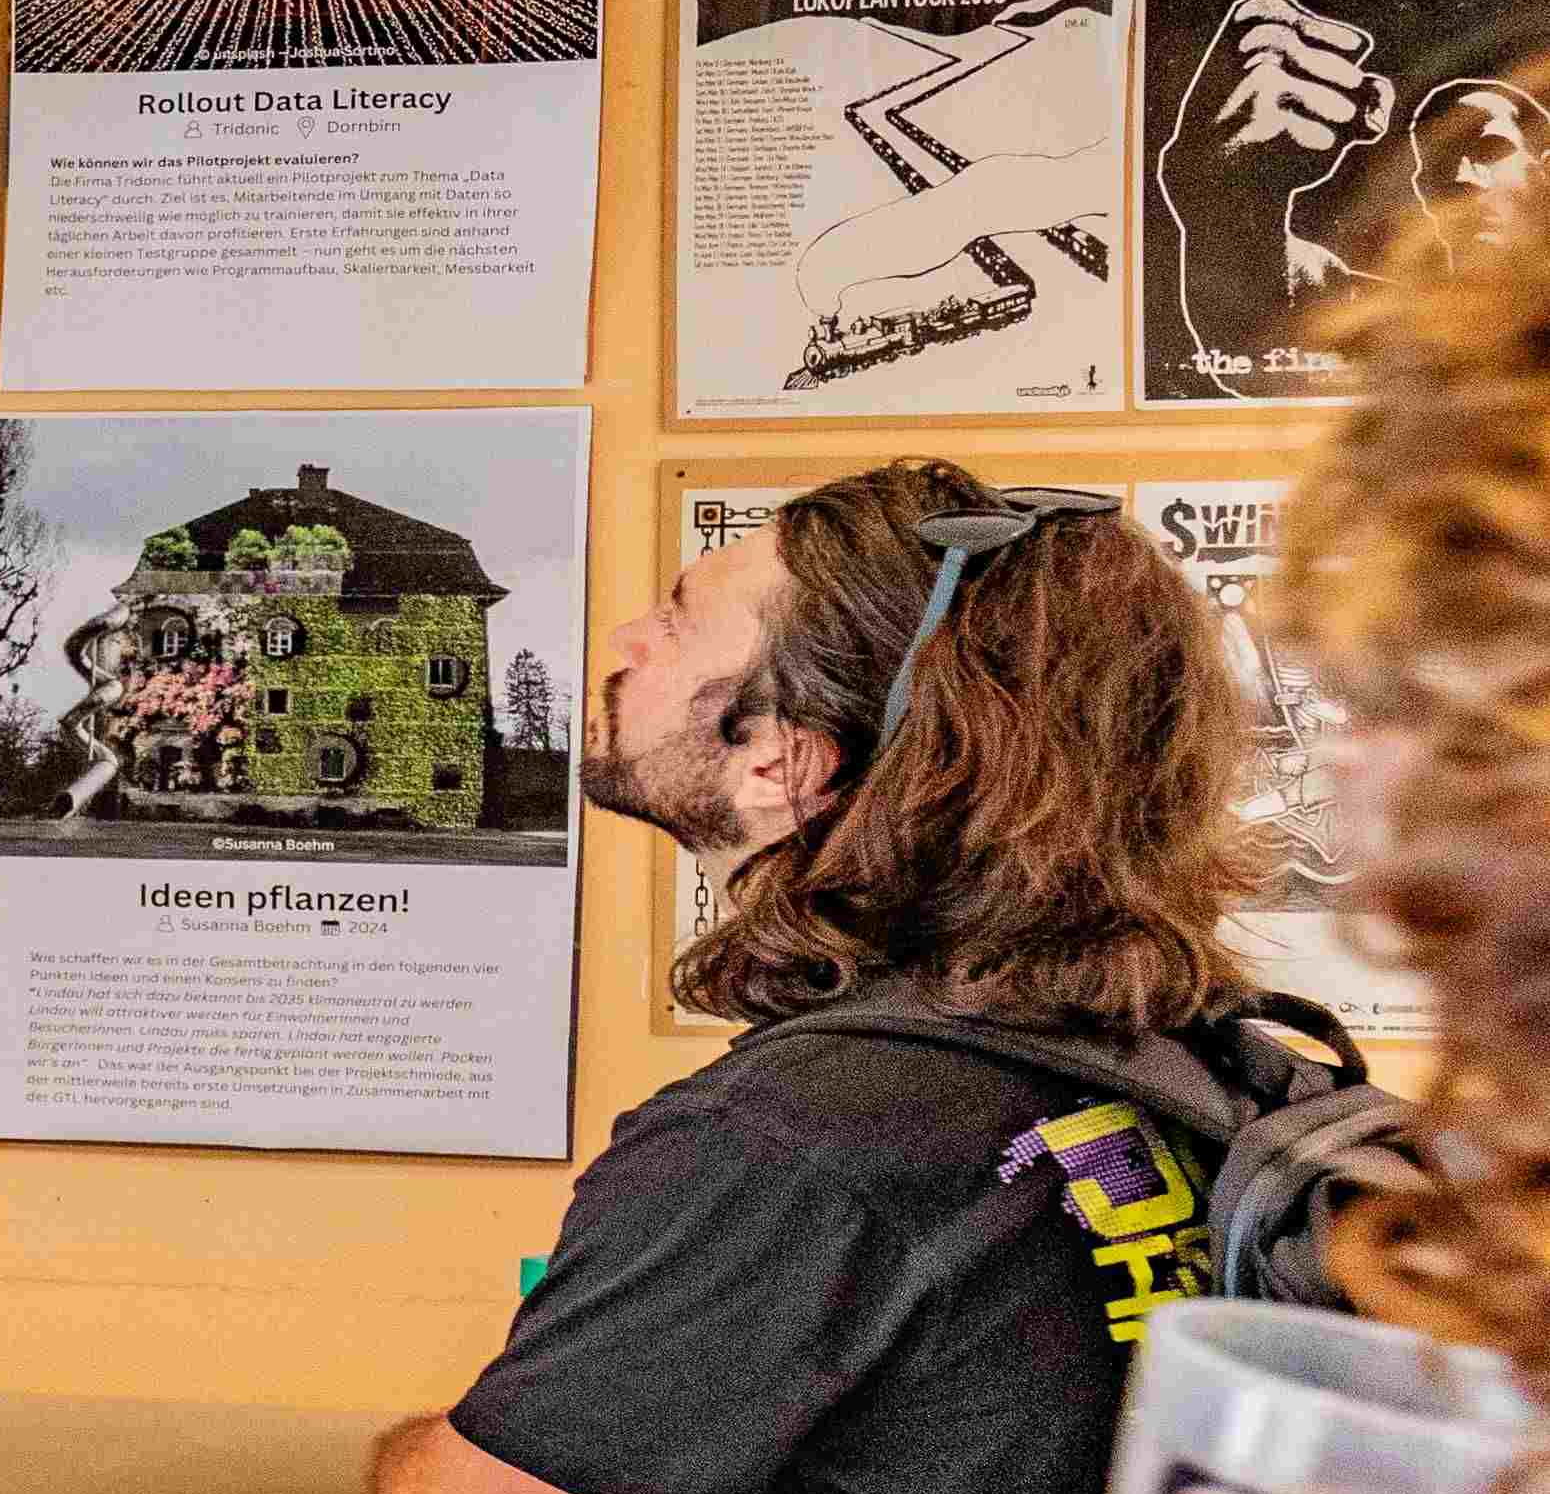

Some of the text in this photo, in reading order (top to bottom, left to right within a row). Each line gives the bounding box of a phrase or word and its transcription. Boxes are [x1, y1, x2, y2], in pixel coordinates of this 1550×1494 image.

[138, 87, 452, 115] Rollout Data Literacy
[212, 119, 401, 136] Tridonic Dornbirn
[50, 152, 360, 169] Wie können wir das Pilotprojekt evaluieren?
[211, 837, 335, 852] ©Susanna Boehm
[140, 882, 409, 917] Ideen pflanzen!
[181, 917, 389, 935] Susanna Boehm 2024
